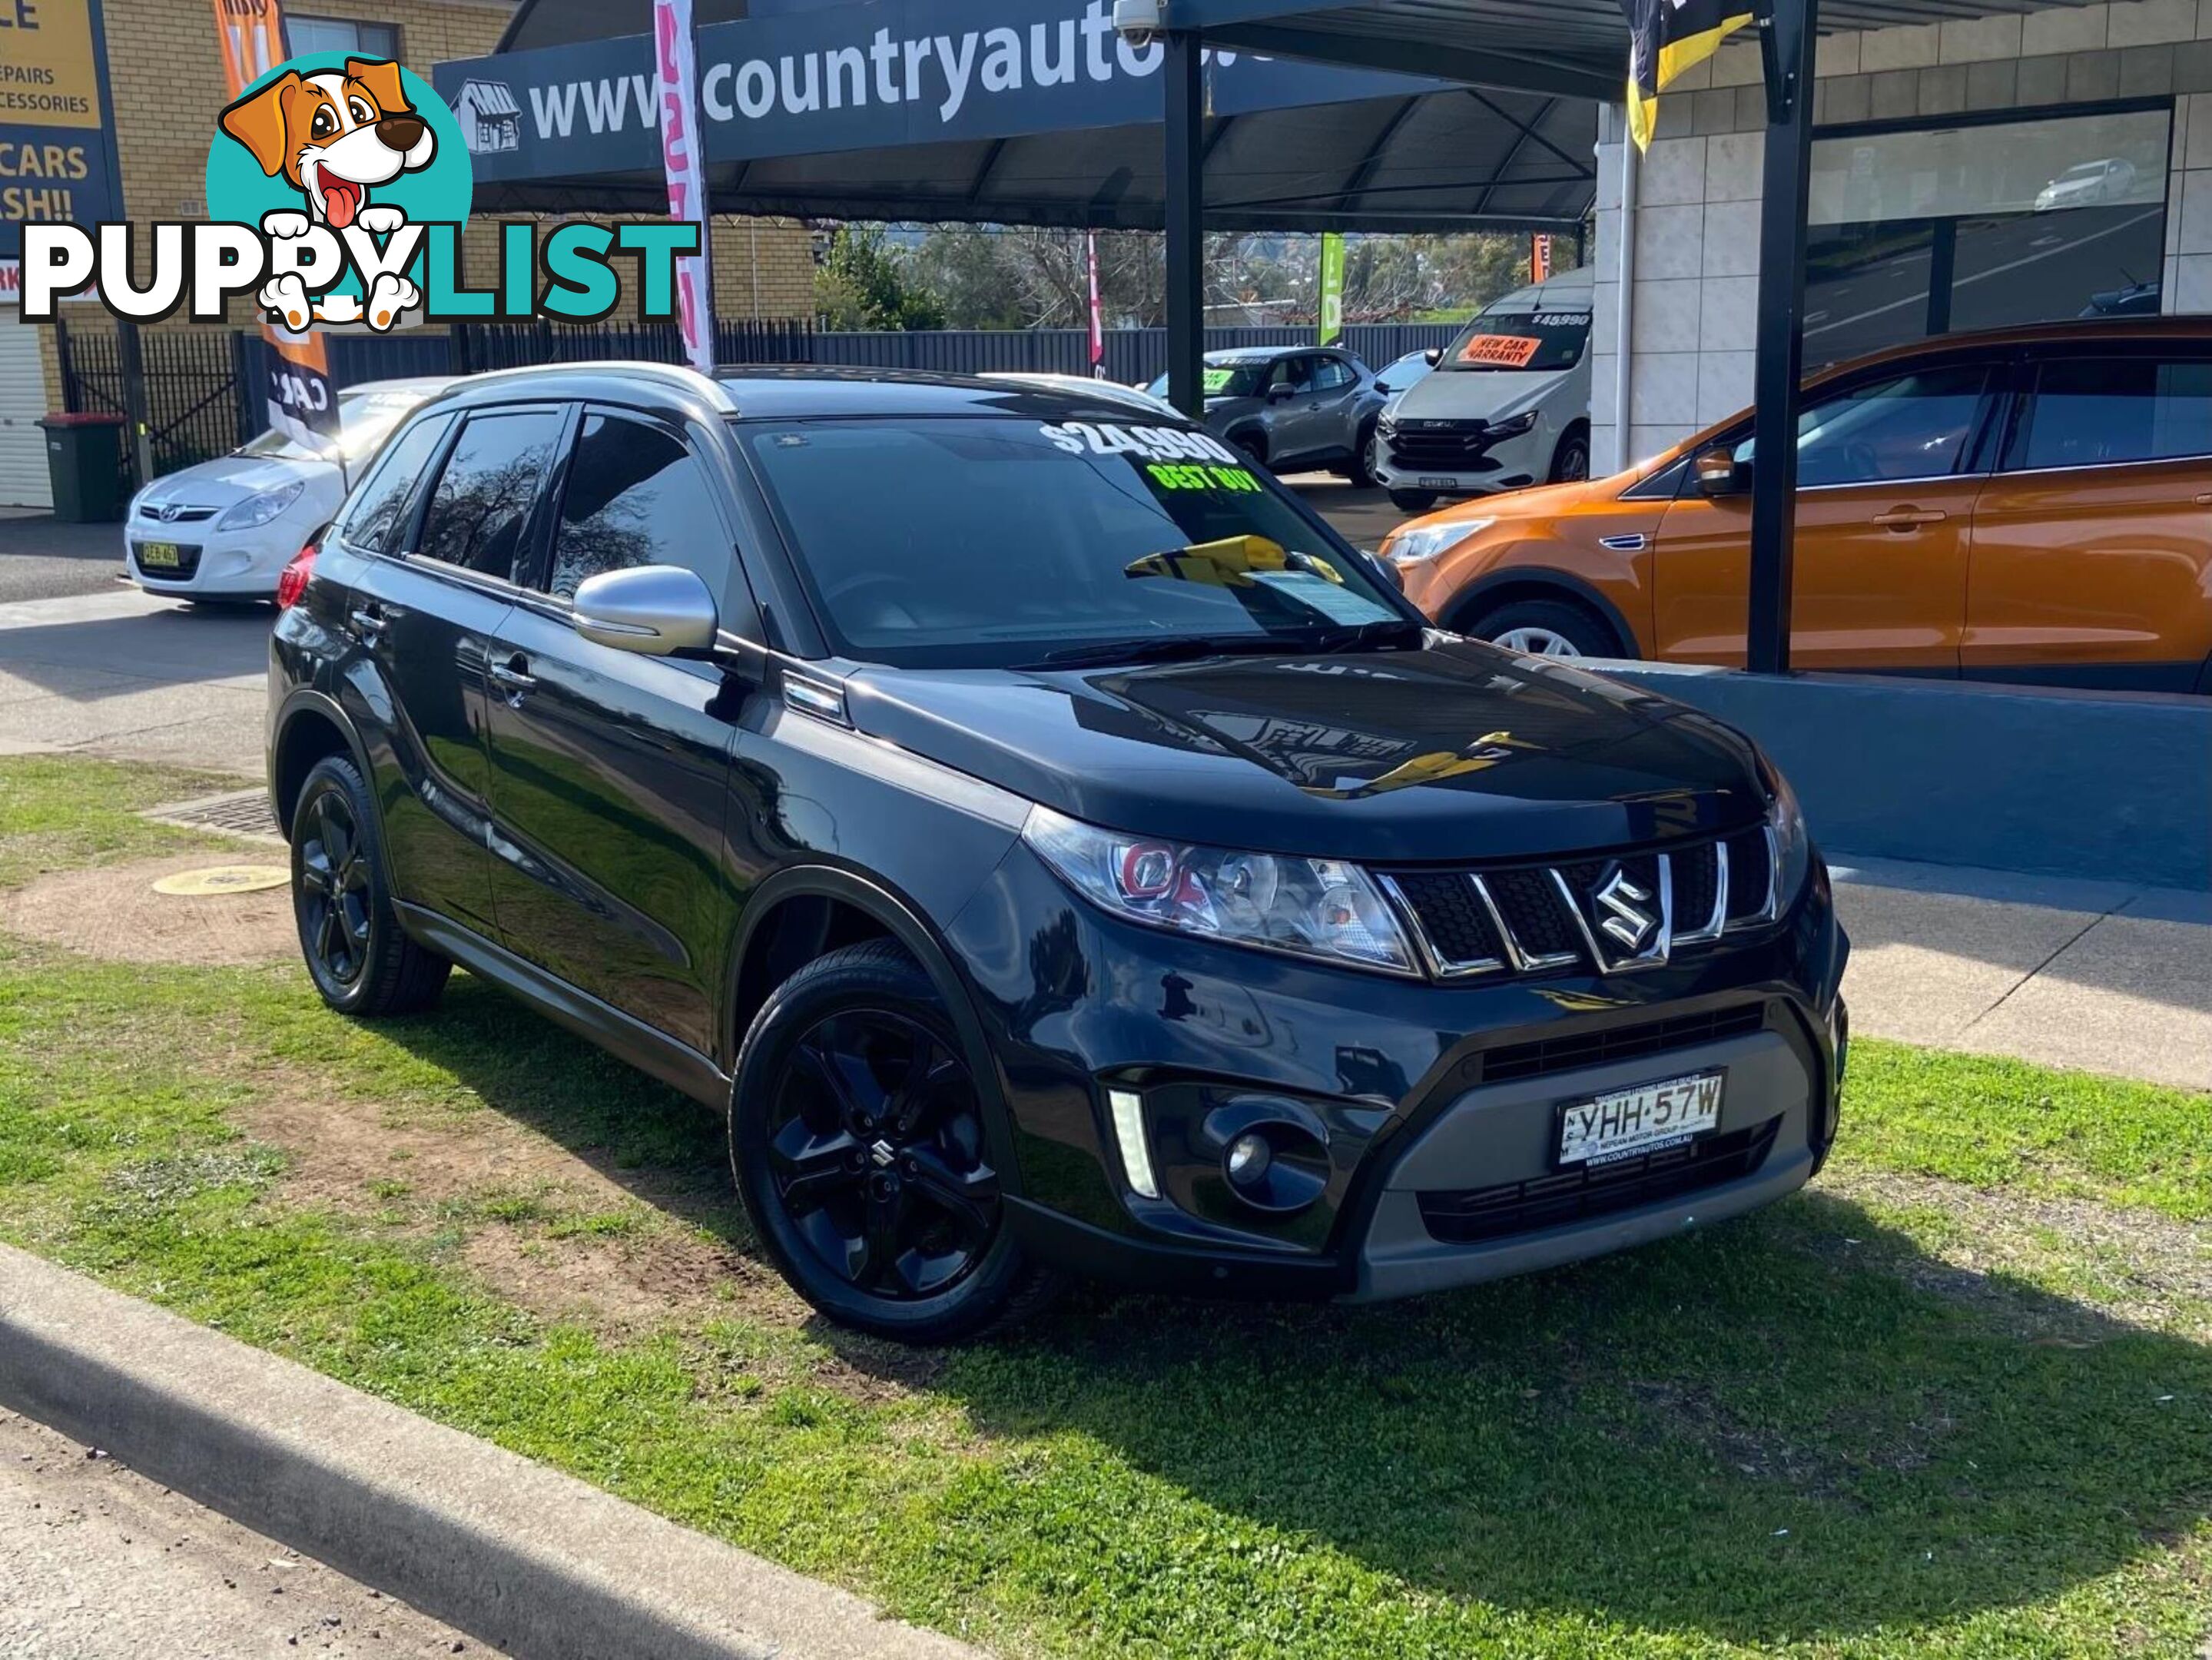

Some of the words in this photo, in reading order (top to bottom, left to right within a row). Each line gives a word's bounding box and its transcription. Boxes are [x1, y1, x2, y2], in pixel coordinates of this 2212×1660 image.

[0, 65, 54, 85] PAIRS
[0, 142, 88, 179] CARS
[0, 187, 73, 221] SH!!
[1467, 349, 1527, 362] WARRANTY
[1478, 337, 1502, 350] NEW
[1504, 339, 1529, 351] CAR
[1039, 421, 1239, 464] $24,990
[1146, 464, 1217, 490] BEST
[1208, 466, 1262, 492] BUY
[1628, 1130, 1653, 1143] MOTOR
